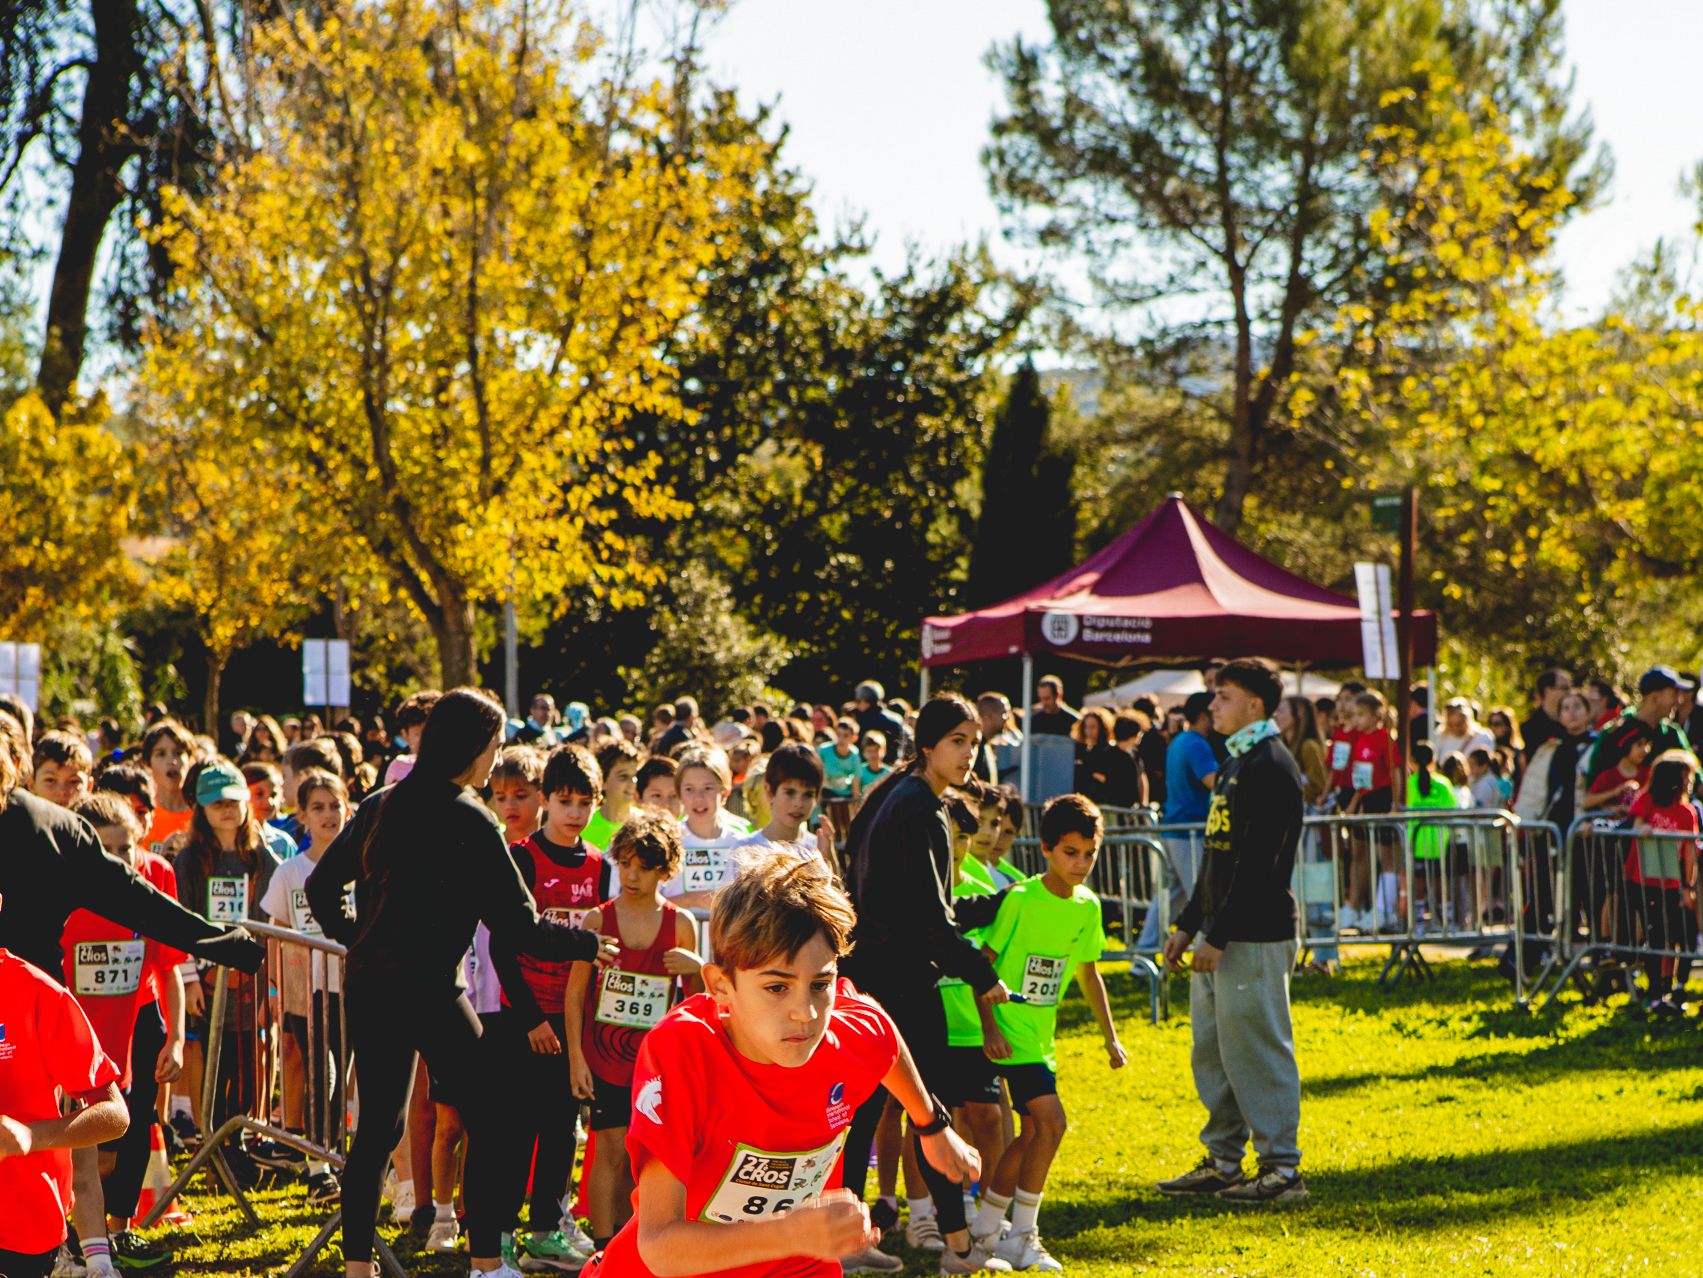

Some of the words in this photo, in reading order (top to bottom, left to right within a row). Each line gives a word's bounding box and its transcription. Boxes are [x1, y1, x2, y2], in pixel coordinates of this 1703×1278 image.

[1083, 614, 1152, 629] Diputació
[1082, 628, 1152, 644] Barcelona
[692, 870, 724, 881] 407
[94, 969, 128, 984] 871
[614, 999, 653, 1017] 369
[738, 1167, 791, 1185] CROS
